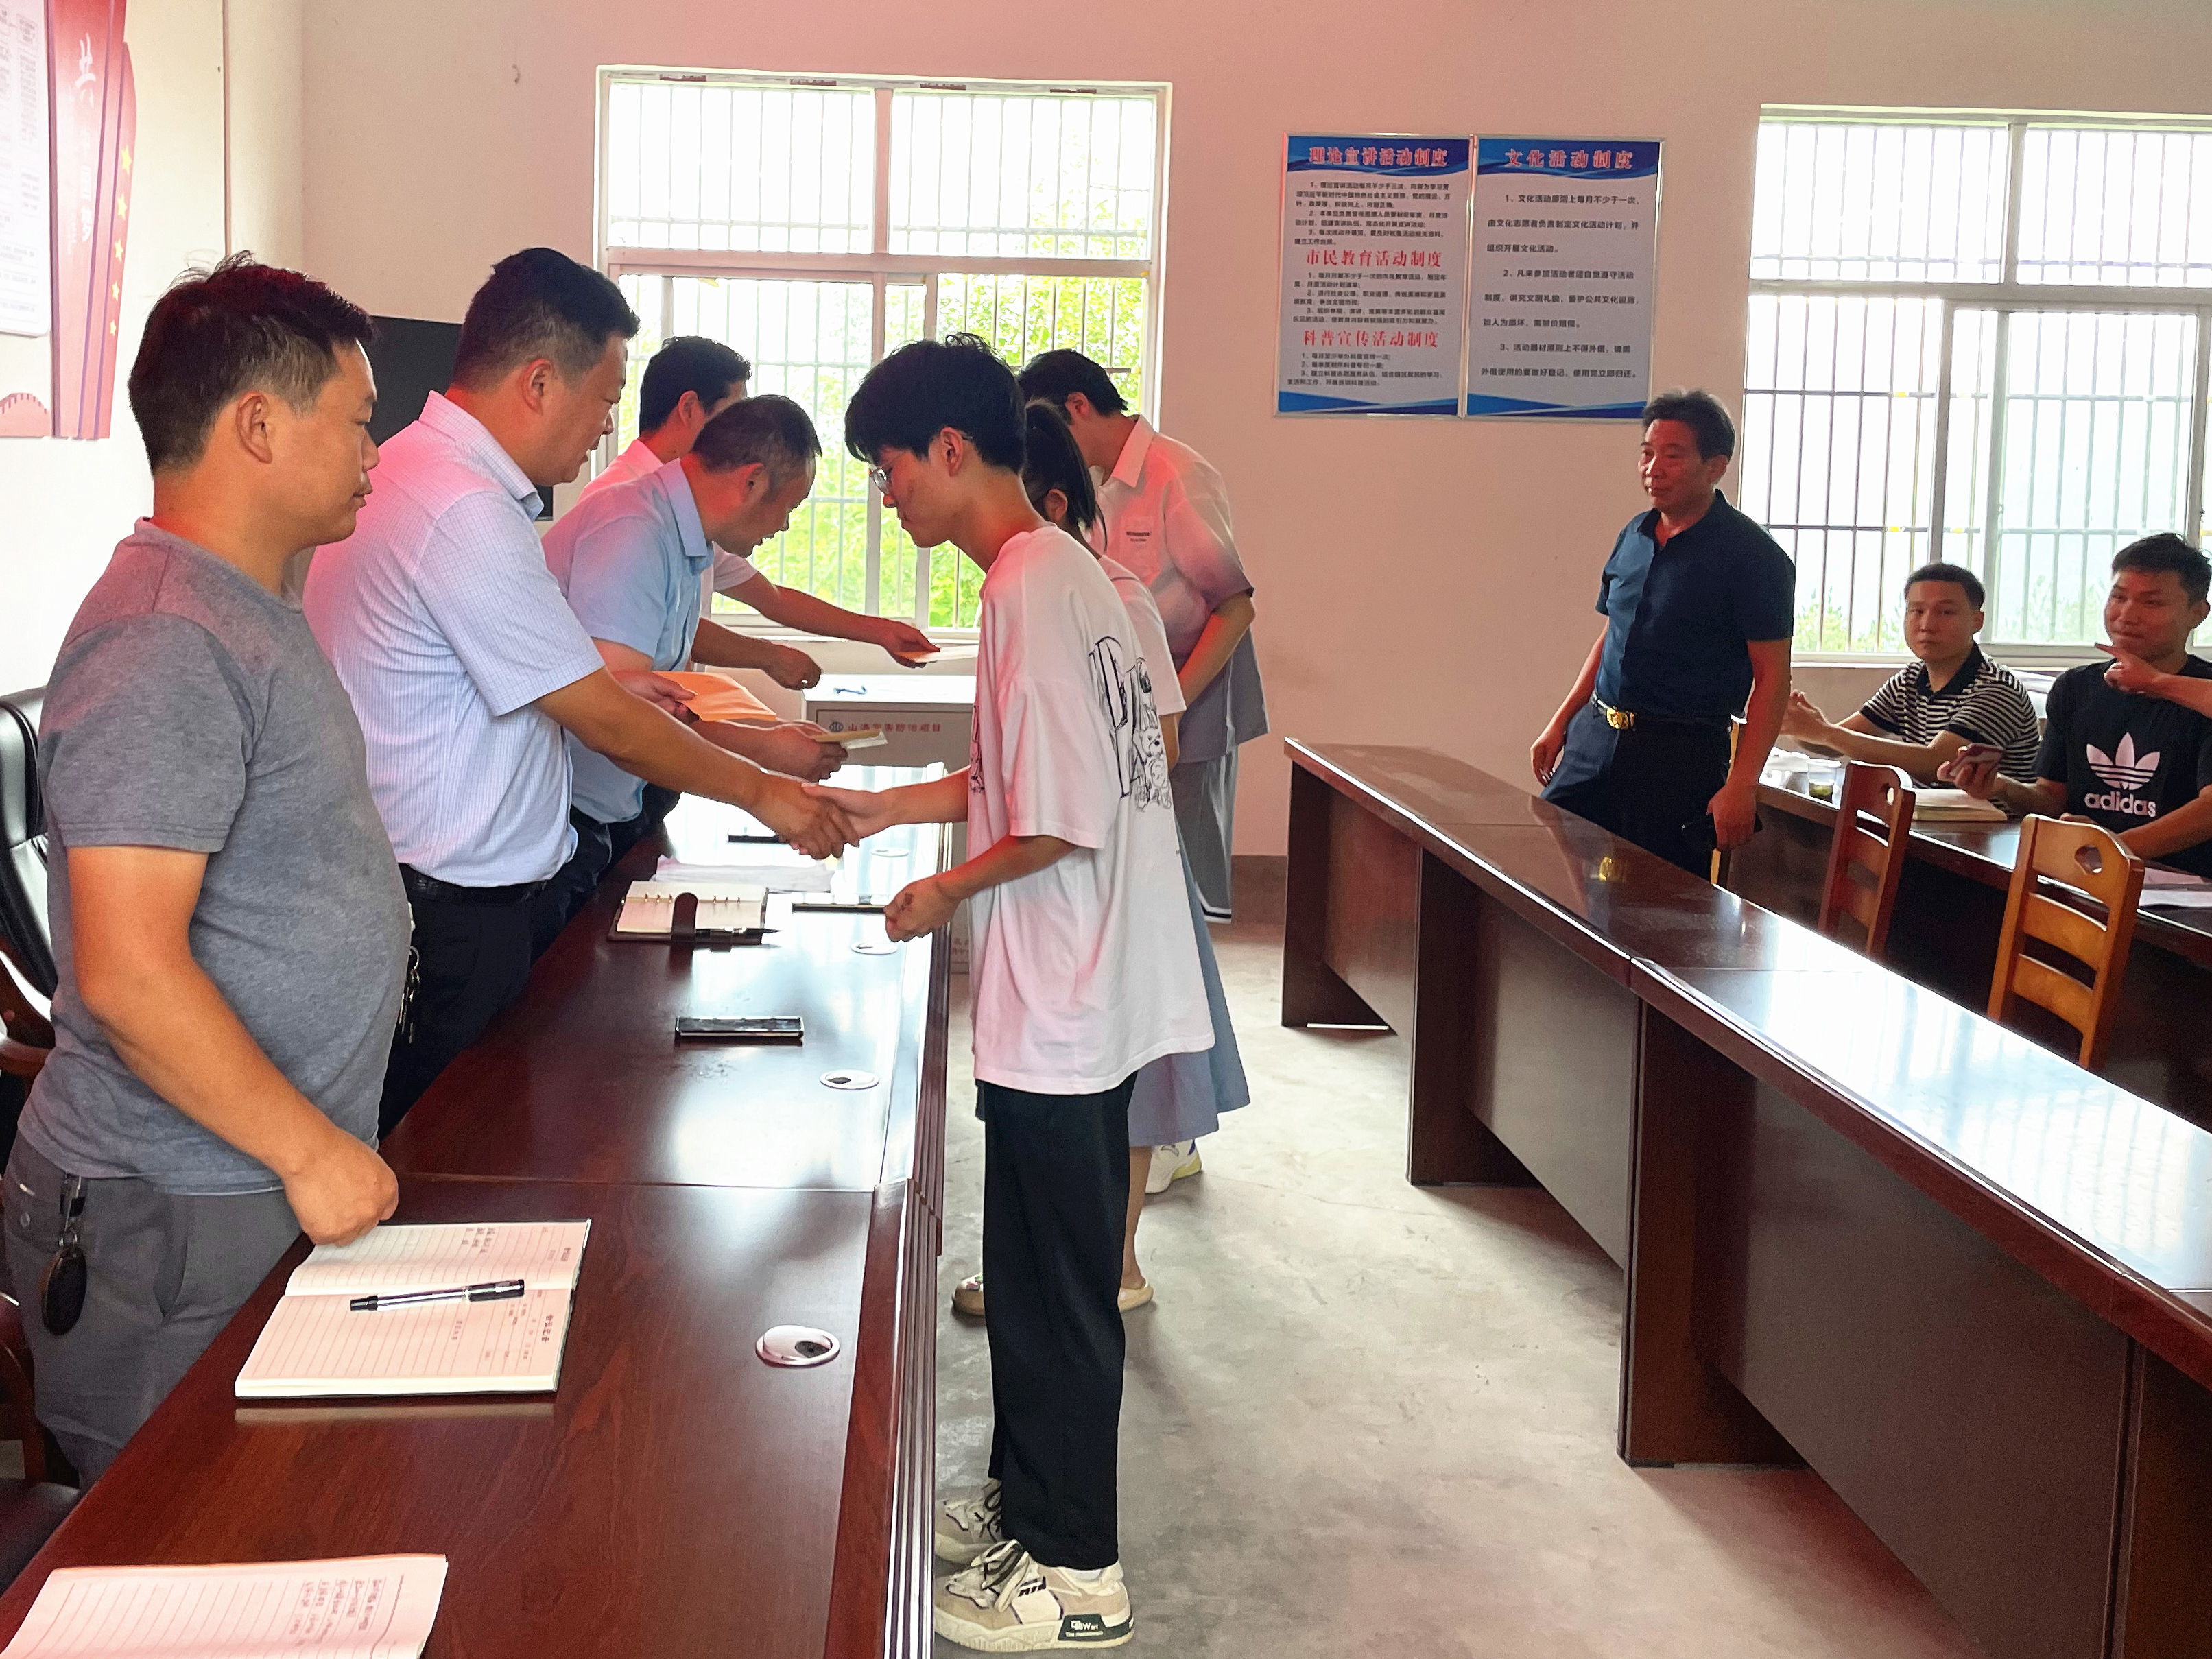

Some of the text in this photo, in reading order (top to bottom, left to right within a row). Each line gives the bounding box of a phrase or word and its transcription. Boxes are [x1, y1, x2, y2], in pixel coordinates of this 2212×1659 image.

[1309, 146, 1448, 167] 理论宣讲活动制度
[1504, 147, 1634, 169] 文化活动制度
[1307, 249, 1442, 267] 市民教育活动制度
[1303, 329, 1438, 348] 科普宣传活动制度
[2084, 791, 2156, 818] adidas
